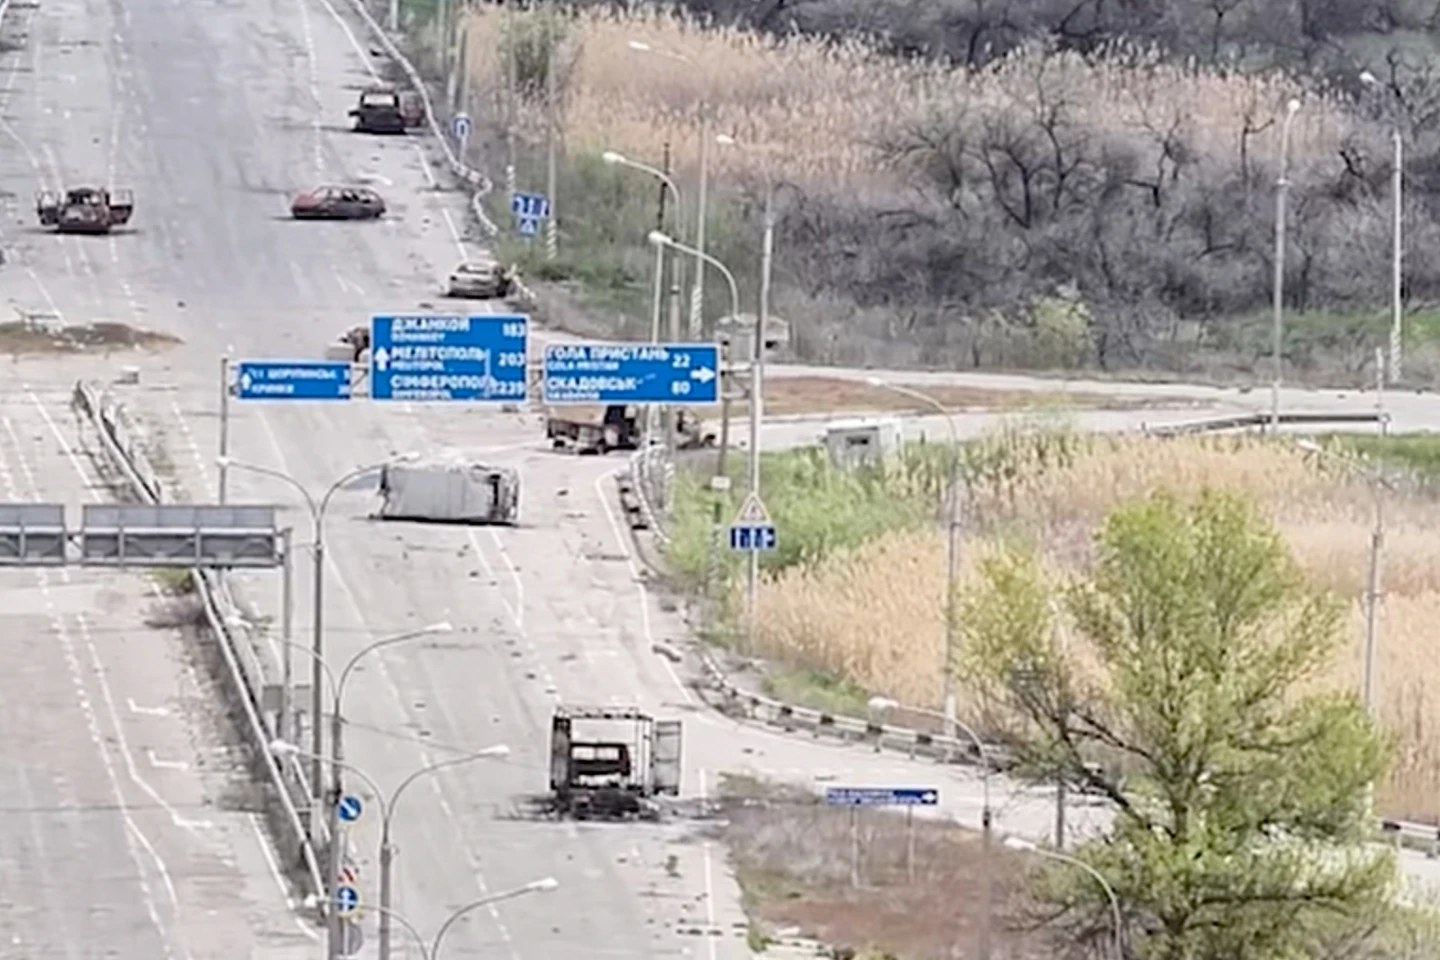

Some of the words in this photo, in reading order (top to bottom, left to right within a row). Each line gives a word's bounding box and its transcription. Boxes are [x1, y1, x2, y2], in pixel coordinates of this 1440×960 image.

[391, 317, 470, 332] ДЖАНКОЙ
[502, 321, 526, 337] 183
[390, 345, 486, 361] МЕЛІТОПОЛЬ
[497, 351, 526, 367] 203
[547, 346, 587, 360] ГОЛА
[589, 346, 670, 361] ПРИСТАНЬ
[672, 352, 691, 368] 22
[547, 376, 637, 391] СКАДОВСЬК
